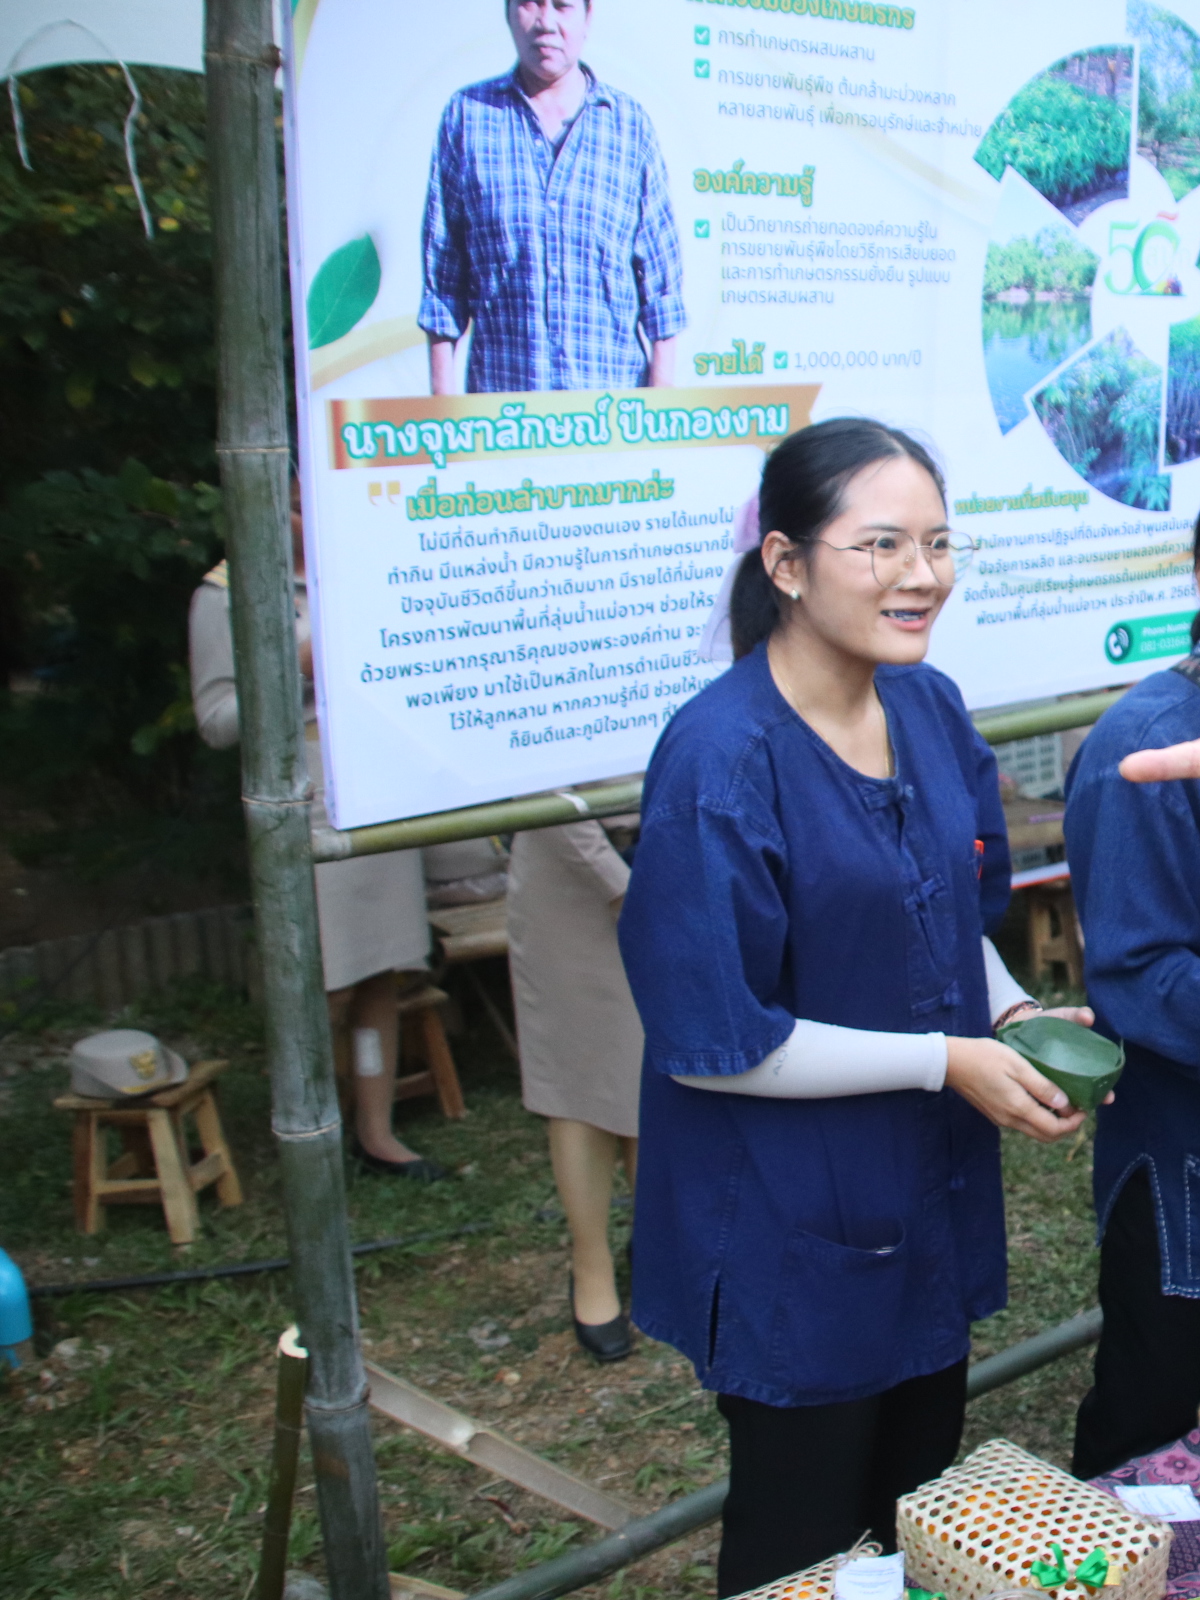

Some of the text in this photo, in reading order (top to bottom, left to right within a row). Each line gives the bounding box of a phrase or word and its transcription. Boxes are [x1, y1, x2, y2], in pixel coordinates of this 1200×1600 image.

[694, 160, 815, 207] องค์ความรู้
[694, 339, 922, 376] รายได้ 1,000,000 บาท/ปี
[343, 393, 789, 468] นางจุฬาลักษณ์ ปันกองงาม
[406, 471, 675, 520] เมื่อก่อนลำบากมากค่ะ
[419, 505, 736, 552] ไม่มีที่ดินทำกินเป็นของตนเอง รายได้แทบไม่
[388, 529, 735, 586] ทำกิน มีแหล่งน้ำ มีความรู้ในการทำเกษตรมากขึ้
[401, 561, 723, 616] ปัจจุบันชีวิตดีขึ้นกว่าเดิมมาก มีรายได้ที่มั่นคง
[660, 590, 718, 613] ช่วยให้ร
[686, 624, 706, 639] จะ
[406, 684, 478, 708] พอเพียง
[449, 703, 547, 732] ไว้ให้ลูกหลาน
[552, 680, 649, 714] หากความรู้ที่มี
[509, 711, 657, 749] ก็ยินดีและภูมิใจมากๆ
